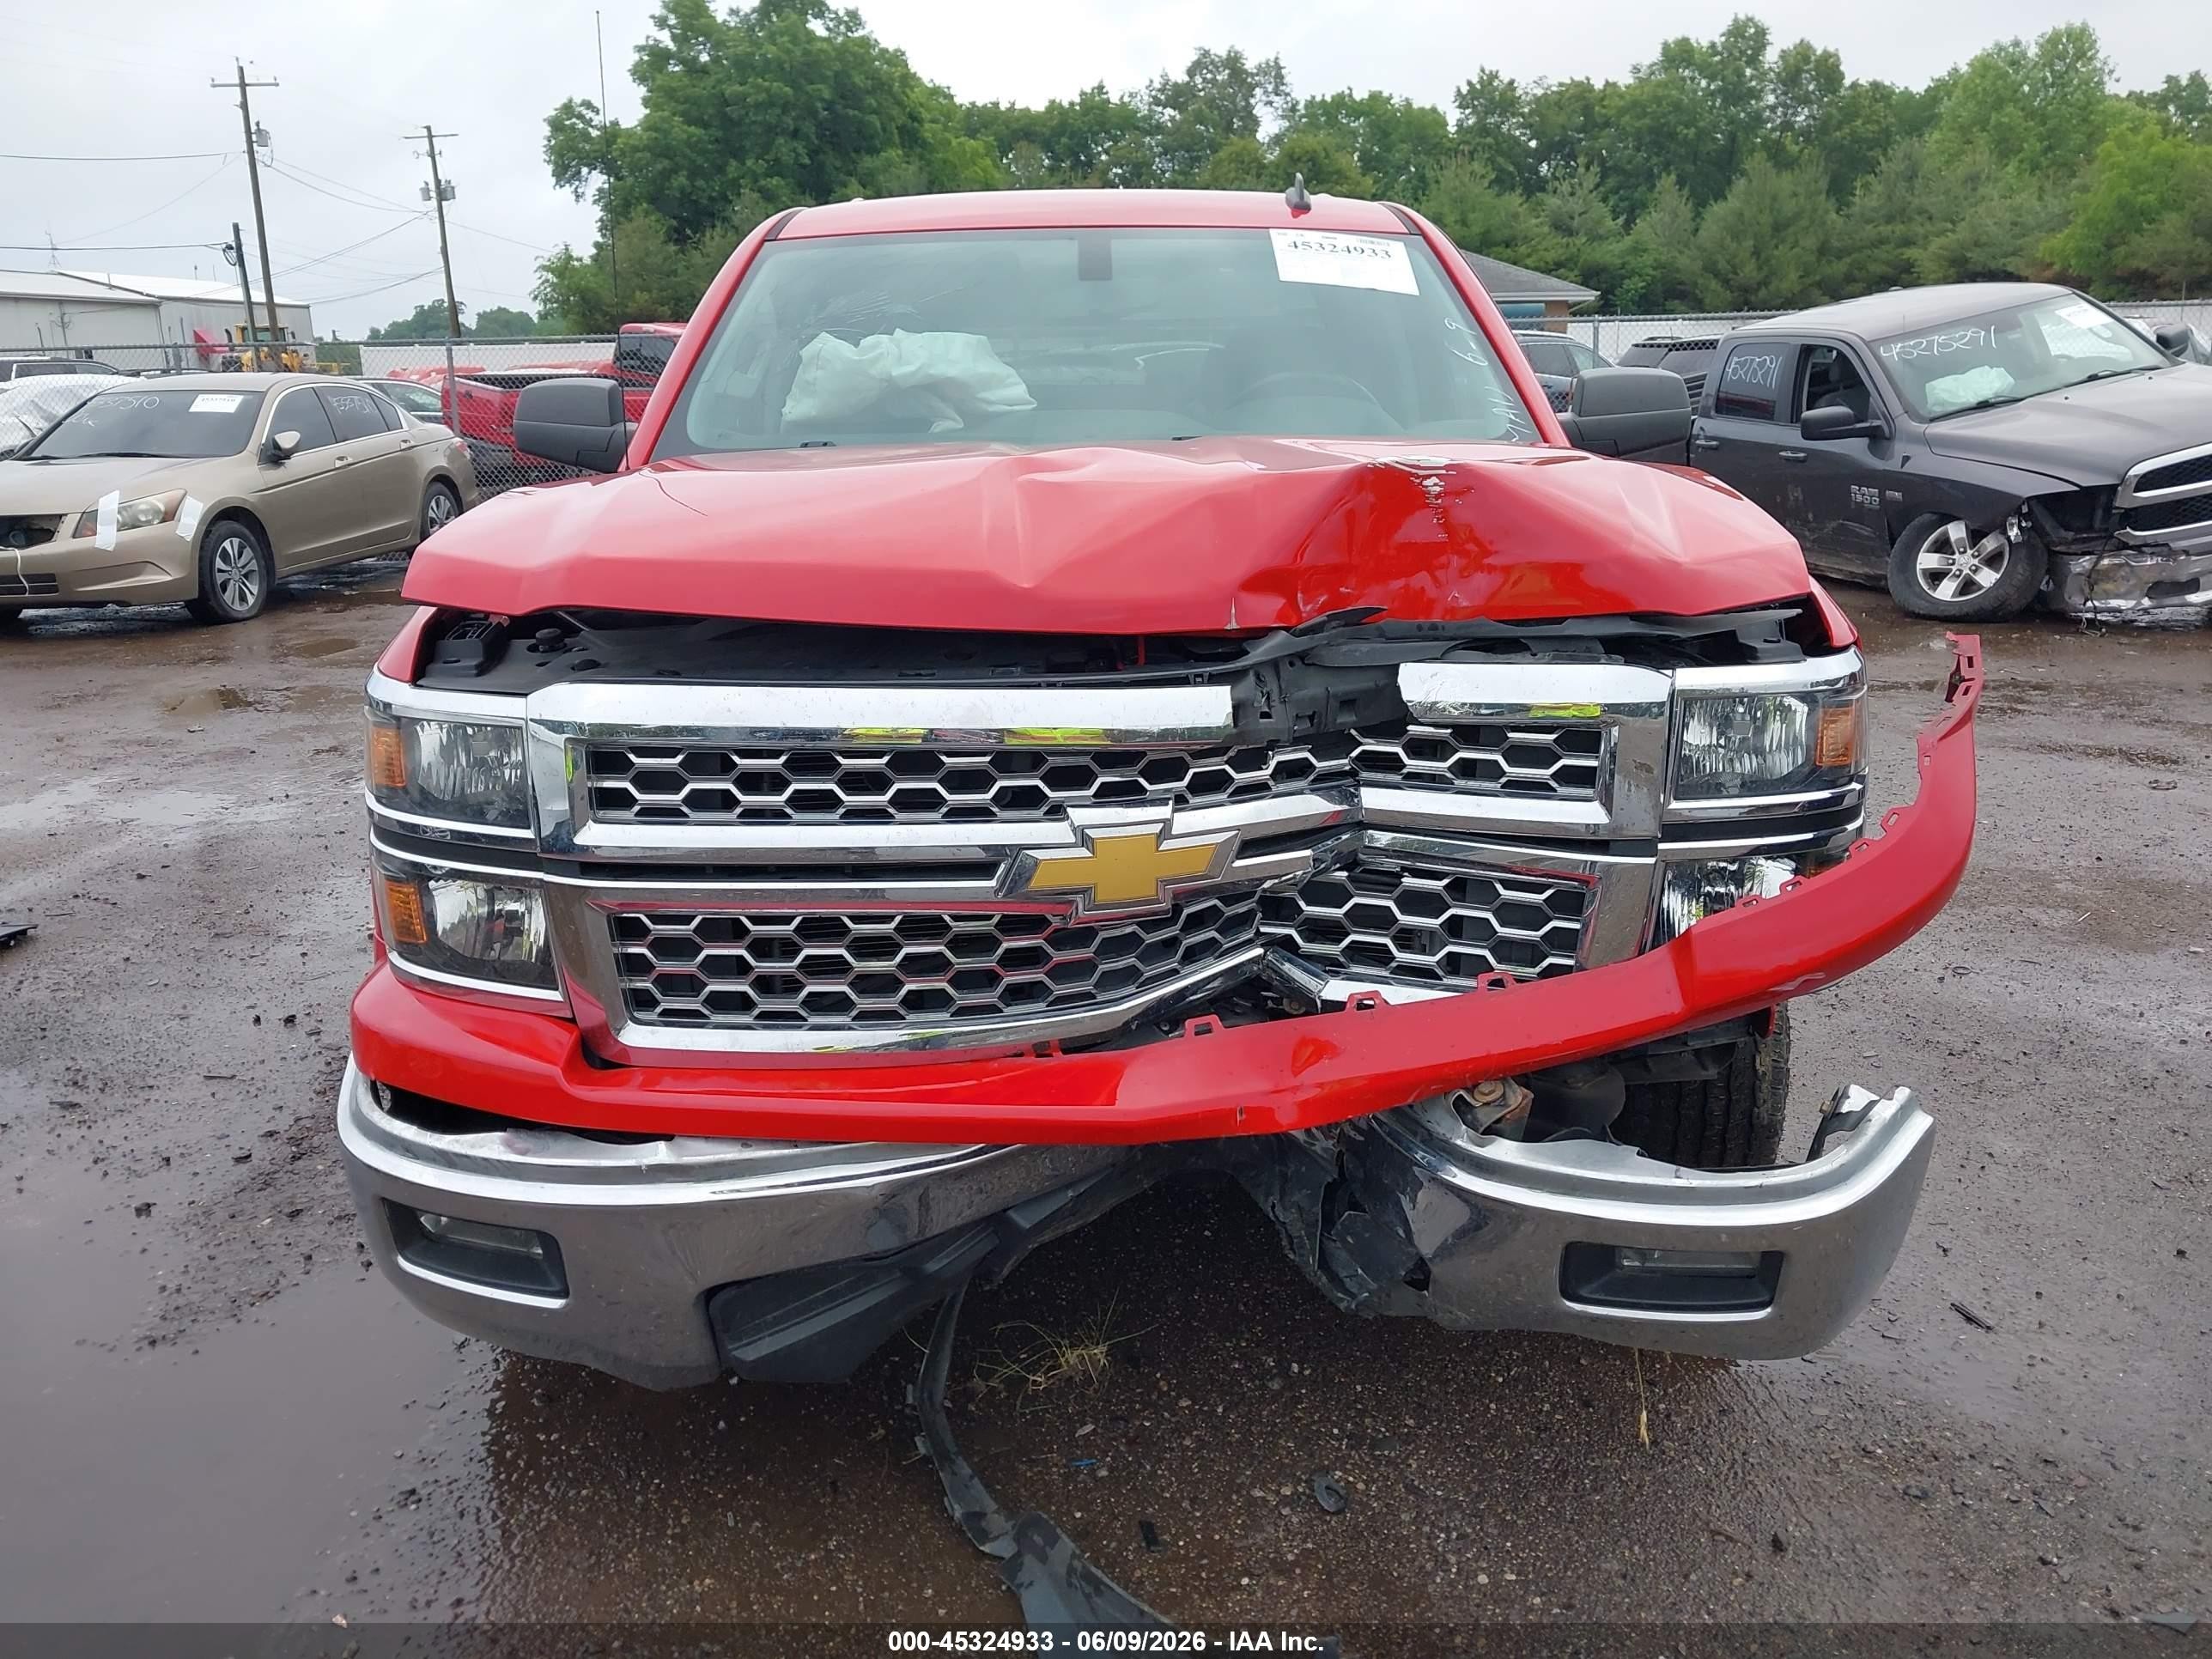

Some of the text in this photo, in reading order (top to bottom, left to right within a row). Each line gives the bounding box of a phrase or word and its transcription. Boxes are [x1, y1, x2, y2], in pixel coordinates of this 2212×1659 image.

[1287, 240, 1392, 259] 45324933
[1881, 325, 1996, 361] 45275291
[1725, 355, 1783, 390] 45275291
[1850, 493, 1880, 505] 1500
